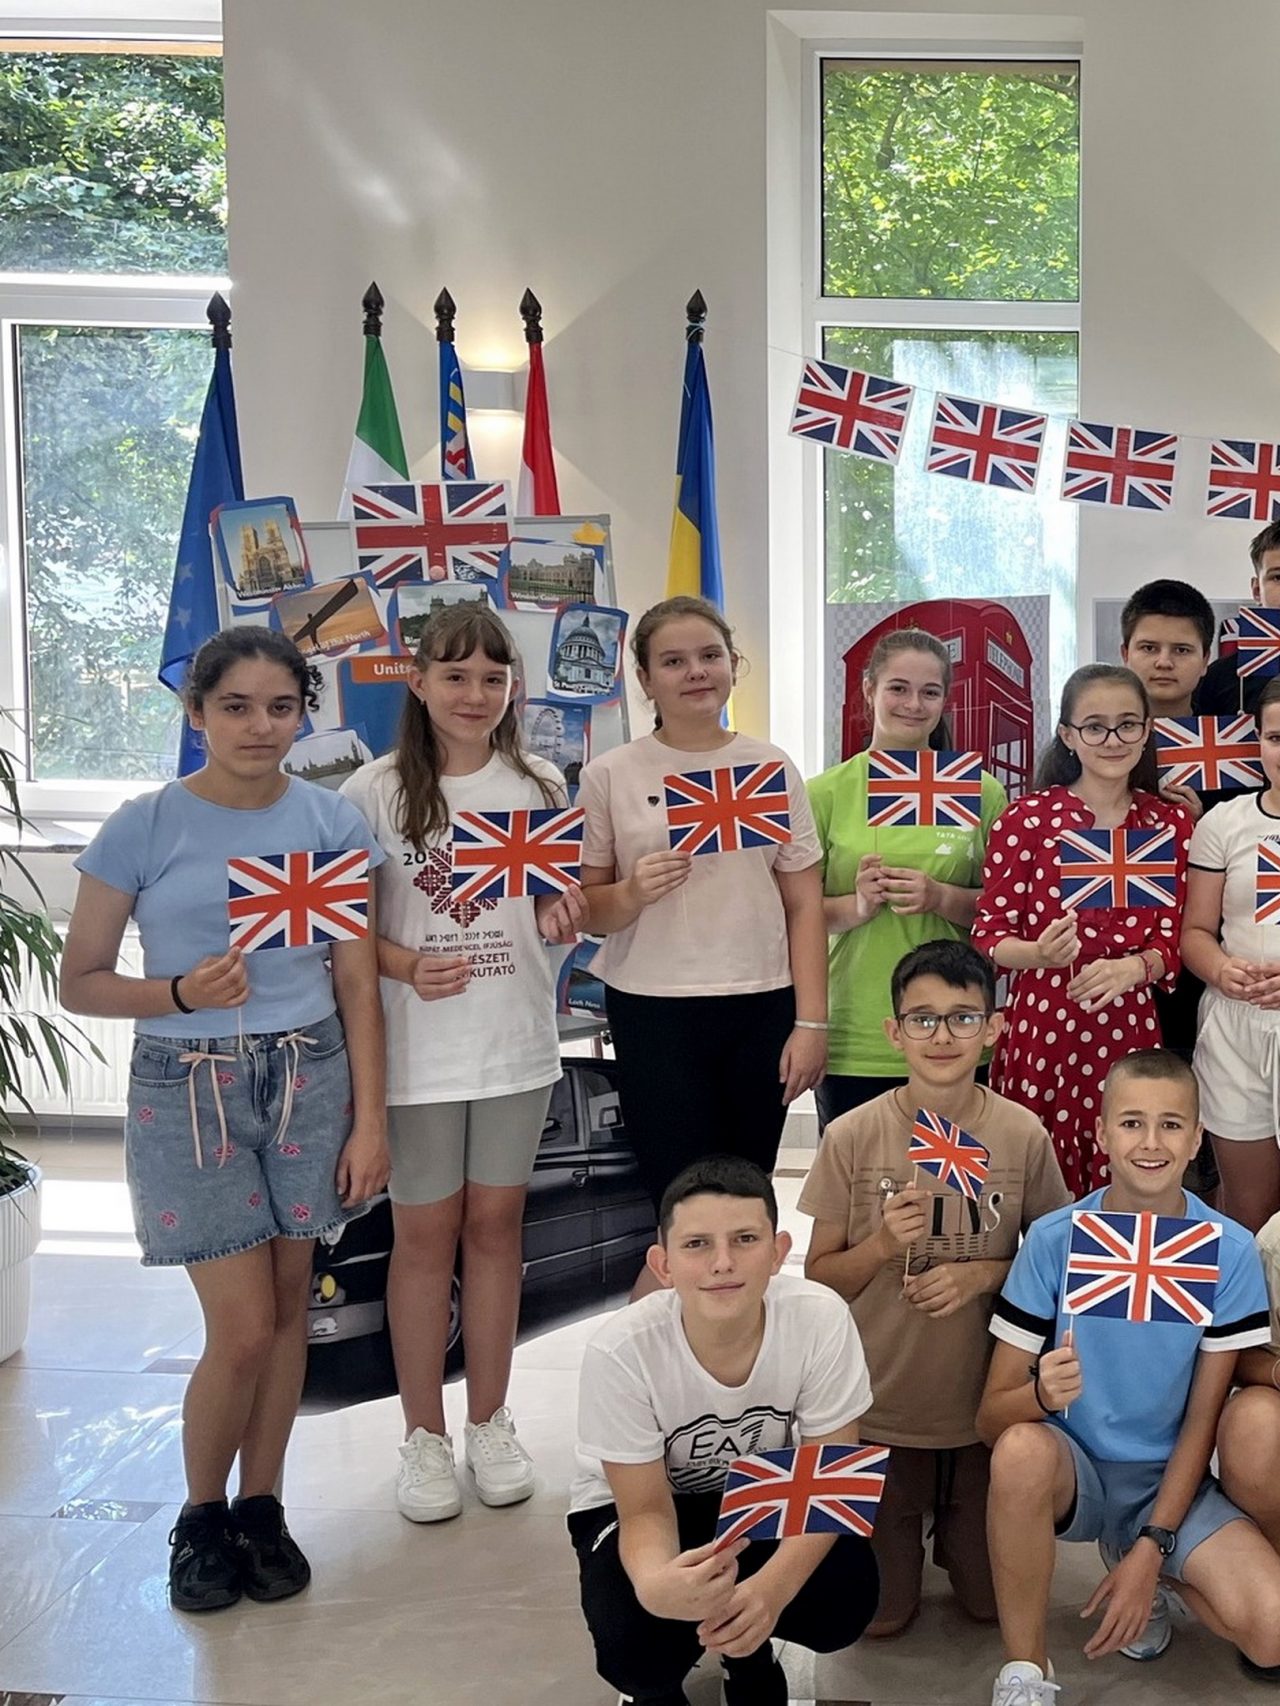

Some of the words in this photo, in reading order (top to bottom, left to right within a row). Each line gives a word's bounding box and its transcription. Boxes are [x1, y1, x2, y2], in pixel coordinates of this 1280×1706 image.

[403, 851, 427, 867] 20
[468, 952, 510, 965] ÉSZETI
[470, 964, 516, 978] KUTATÓ
